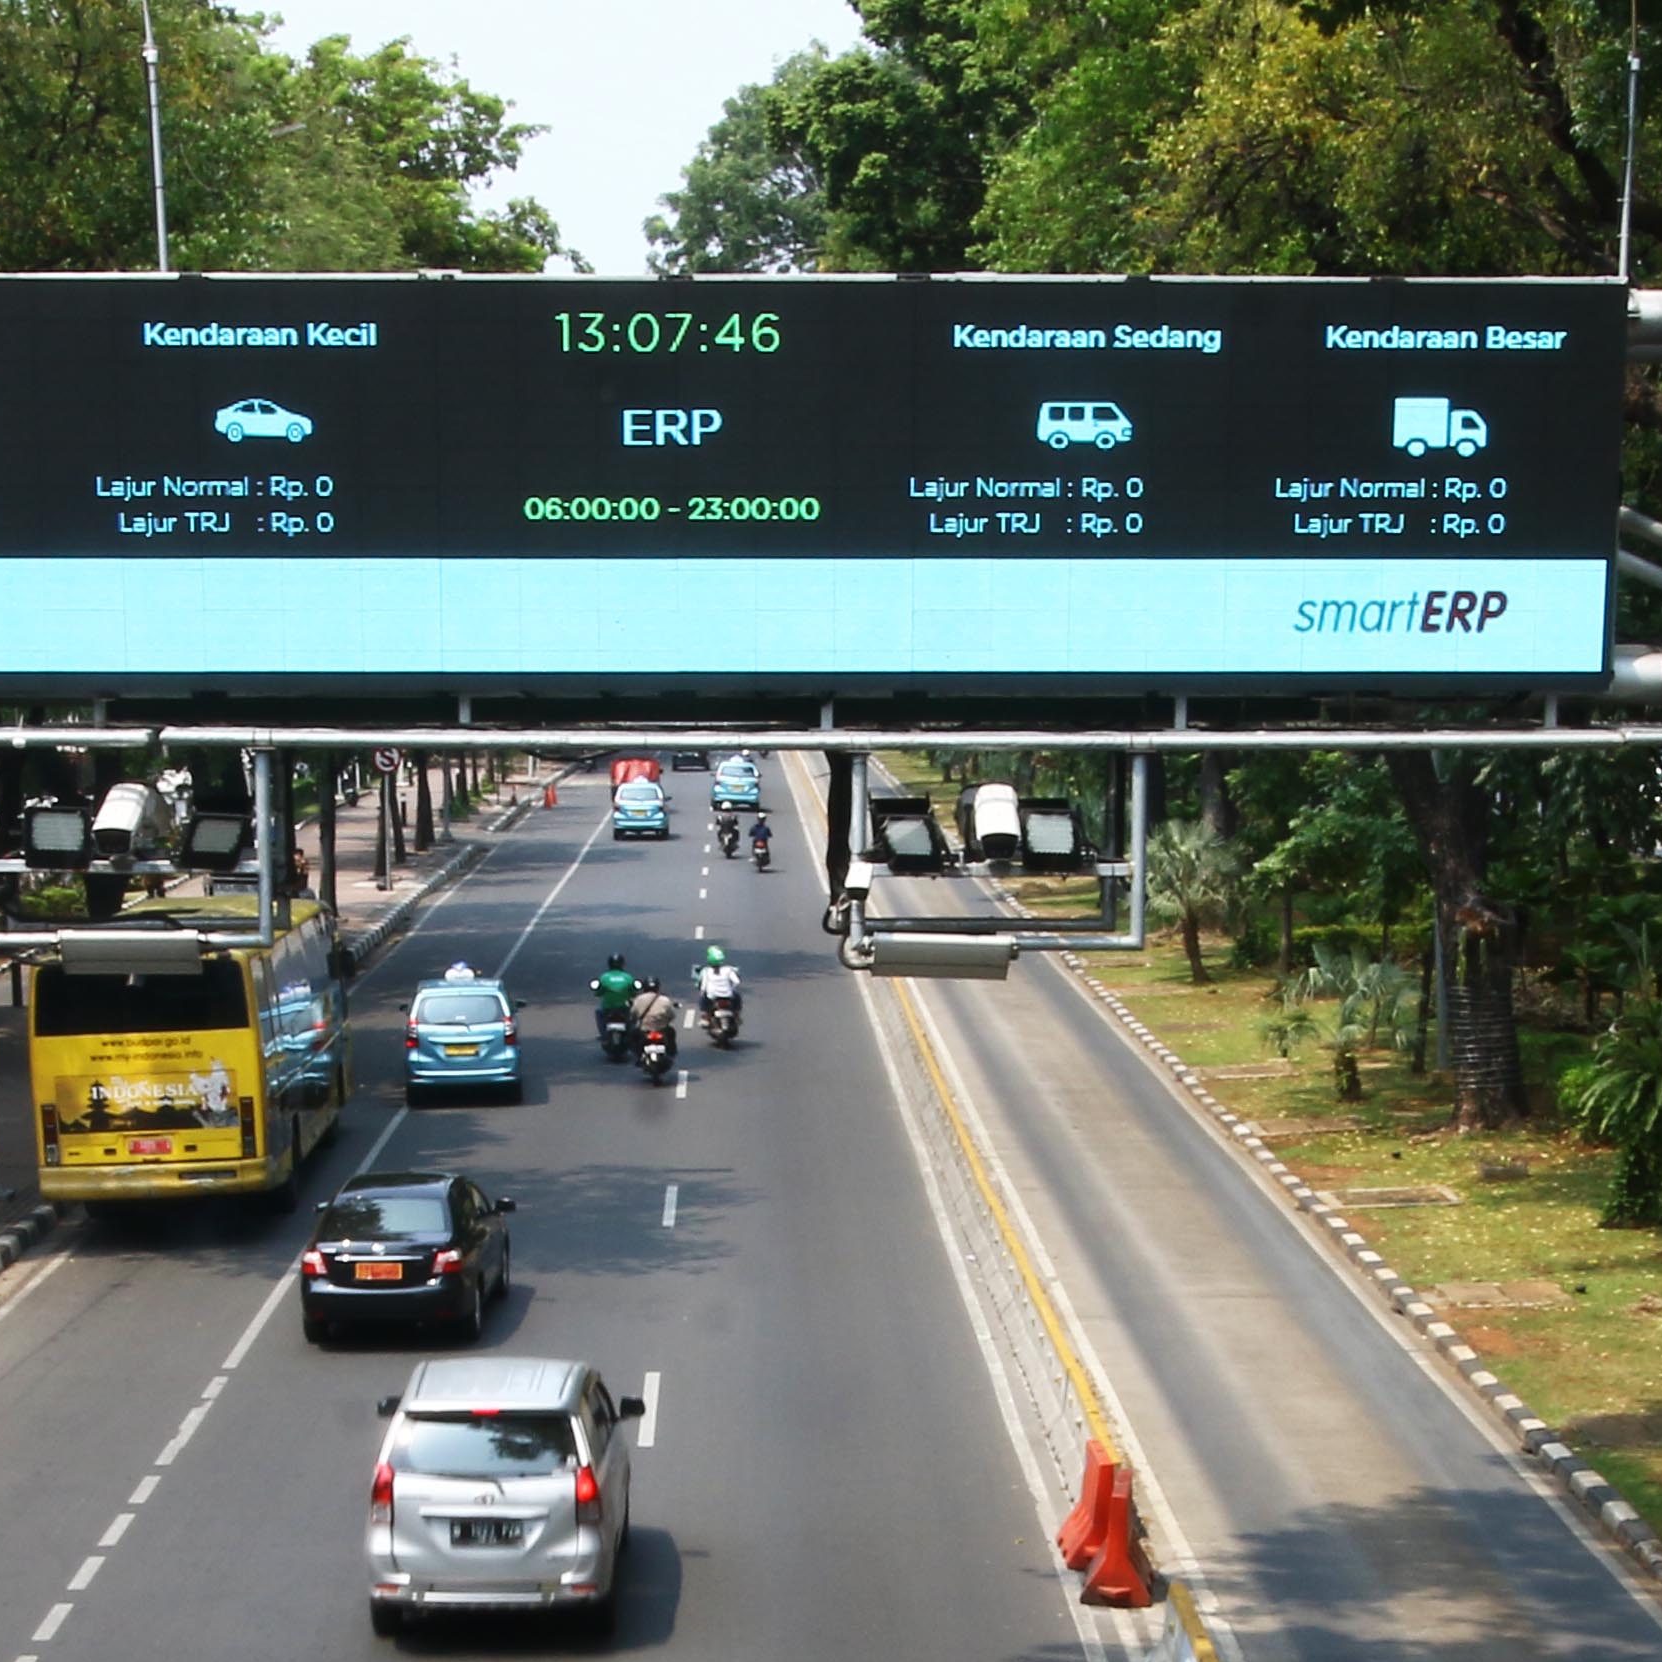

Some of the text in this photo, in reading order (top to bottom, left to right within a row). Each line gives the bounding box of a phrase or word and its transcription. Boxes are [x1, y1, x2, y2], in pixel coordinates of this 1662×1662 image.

[143, 322, 377, 346] Kendaraan Kecil
[554, 312, 780, 353] 13:07:46
[953, 324, 1222, 354] Kendaraan Sedang
[1325, 325, 1568, 350] Kendaraan Besar
[622, 409, 723, 446] ERP
[96, 475, 157, 502] Lajur
[163, 475, 249, 497] Normal
[269, 475, 309, 502] Rp.
[909, 476, 970, 503] Lajur
[976, 476, 1061, 498] Normal
[1081, 477, 1119, 503] Rp.
[1275, 477, 1335, 503] Lajur
[1339, 477, 1426, 499] Normal
[1444, 477, 1482, 503] Rp.
[523, 497, 661, 521] 06:00:00
[688, 497, 821, 521] 23:00:00
[118, 511, 178, 538] Lajur
[183, 511, 230, 533] TRJ
[269, 511, 310, 538] Rp.
[929, 512, 989, 538] Lajur
[995, 512, 1041, 534] TRJ
[1080, 512, 1119, 539] Rp.
[1294, 513, 1353, 539] Lajur
[1358, 512, 1405, 534] TRJ
[1442, 513, 1480, 539] Rp.
[1294, 590, 1508, 633] smartERP
[92, 1081, 199, 1100] INDONESIA
